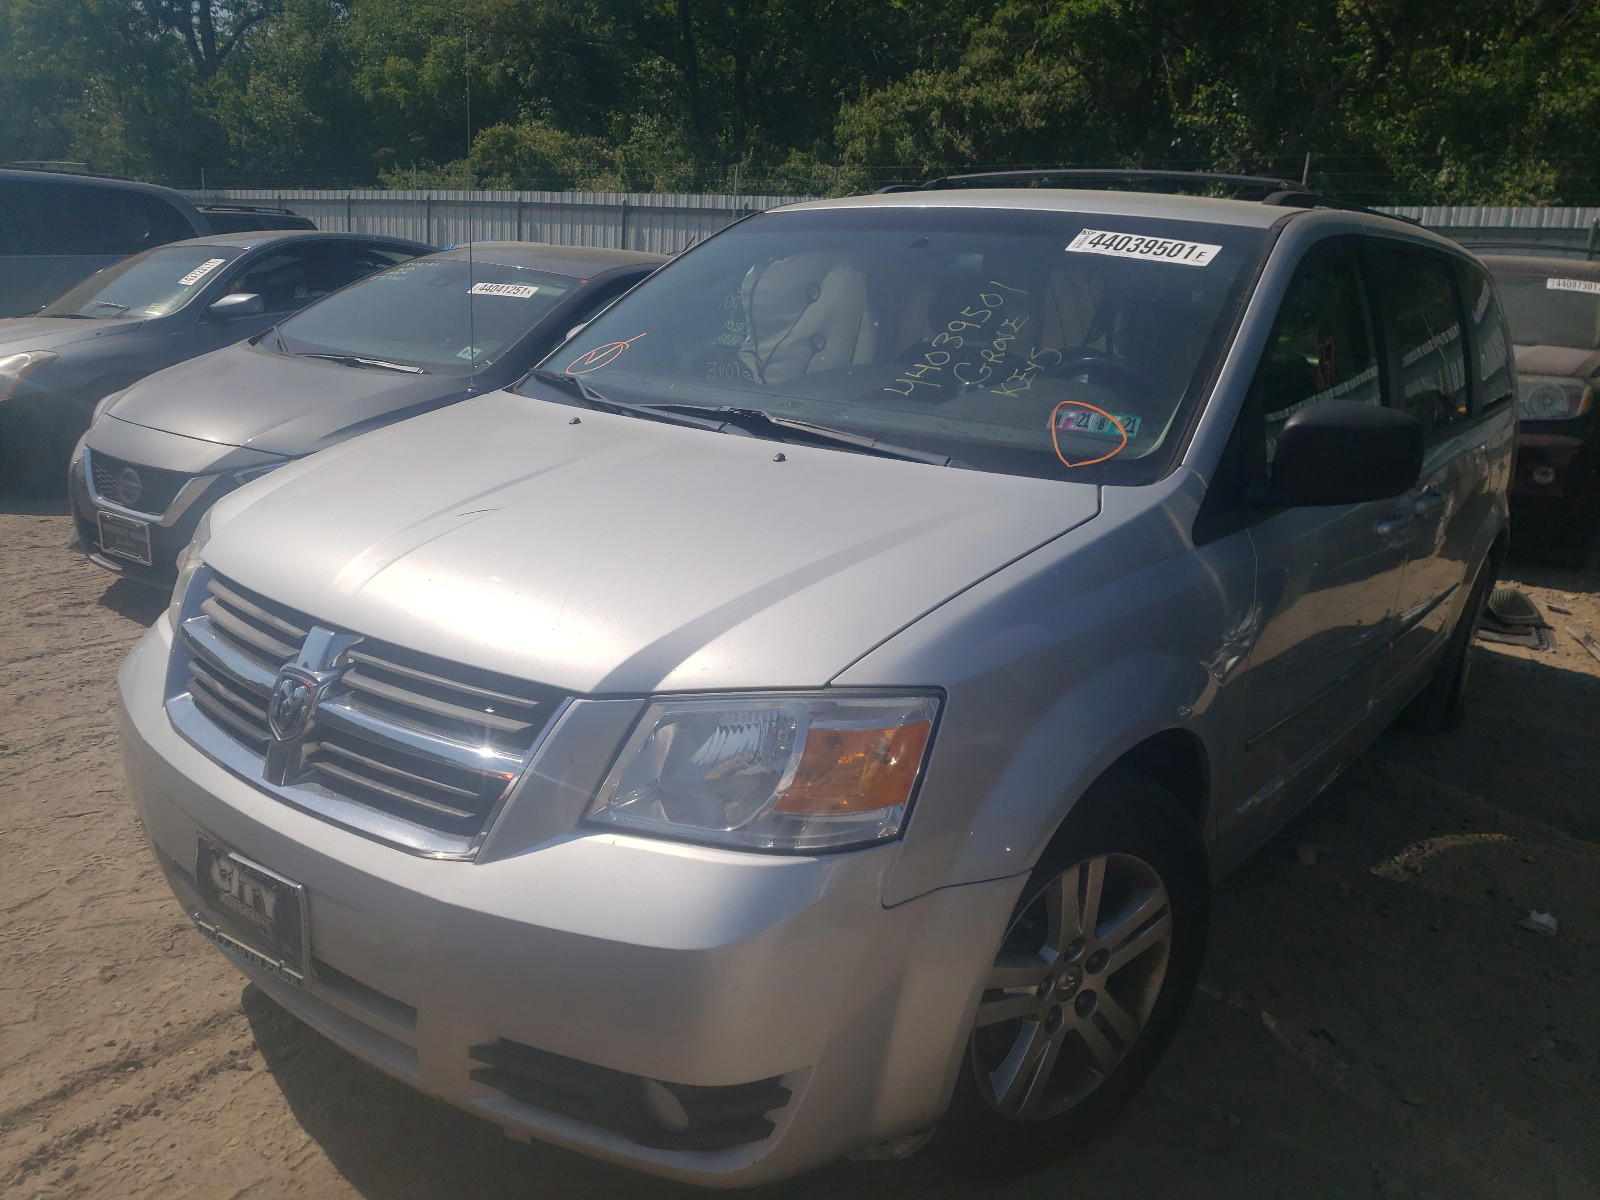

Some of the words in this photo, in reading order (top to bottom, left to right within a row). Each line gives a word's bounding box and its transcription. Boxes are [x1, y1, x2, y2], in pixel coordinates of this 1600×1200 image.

[1087, 233, 1198, 260] 44039501
[479, 284, 529, 295] 44041251
[954, 315, 1030, 385] GROVE
[990, 346, 1063, 399] KEYS
[1076, 413, 1092, 428] 21
